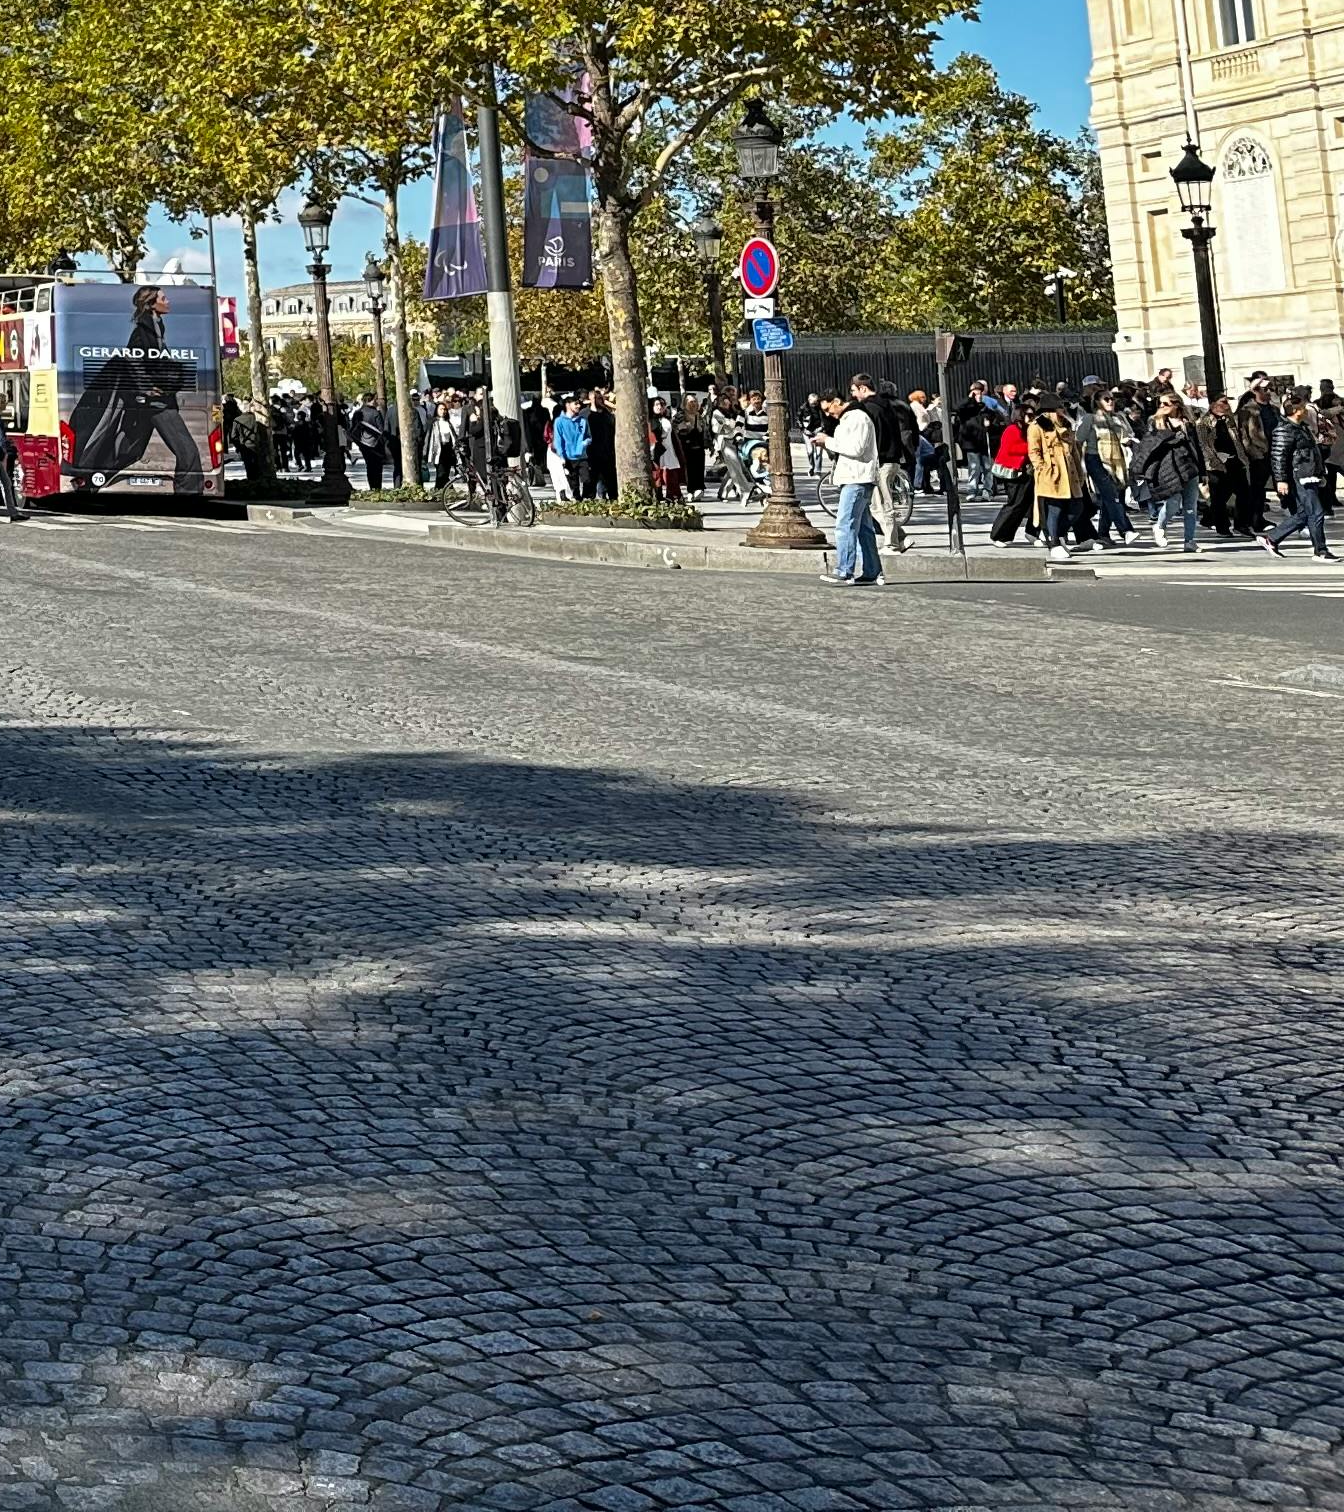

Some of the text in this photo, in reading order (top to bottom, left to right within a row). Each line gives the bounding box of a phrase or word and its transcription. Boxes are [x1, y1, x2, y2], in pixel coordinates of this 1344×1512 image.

[538, 256, 575, 267] PARIS
[79, 347, 199, 360] GERARD DAREL
